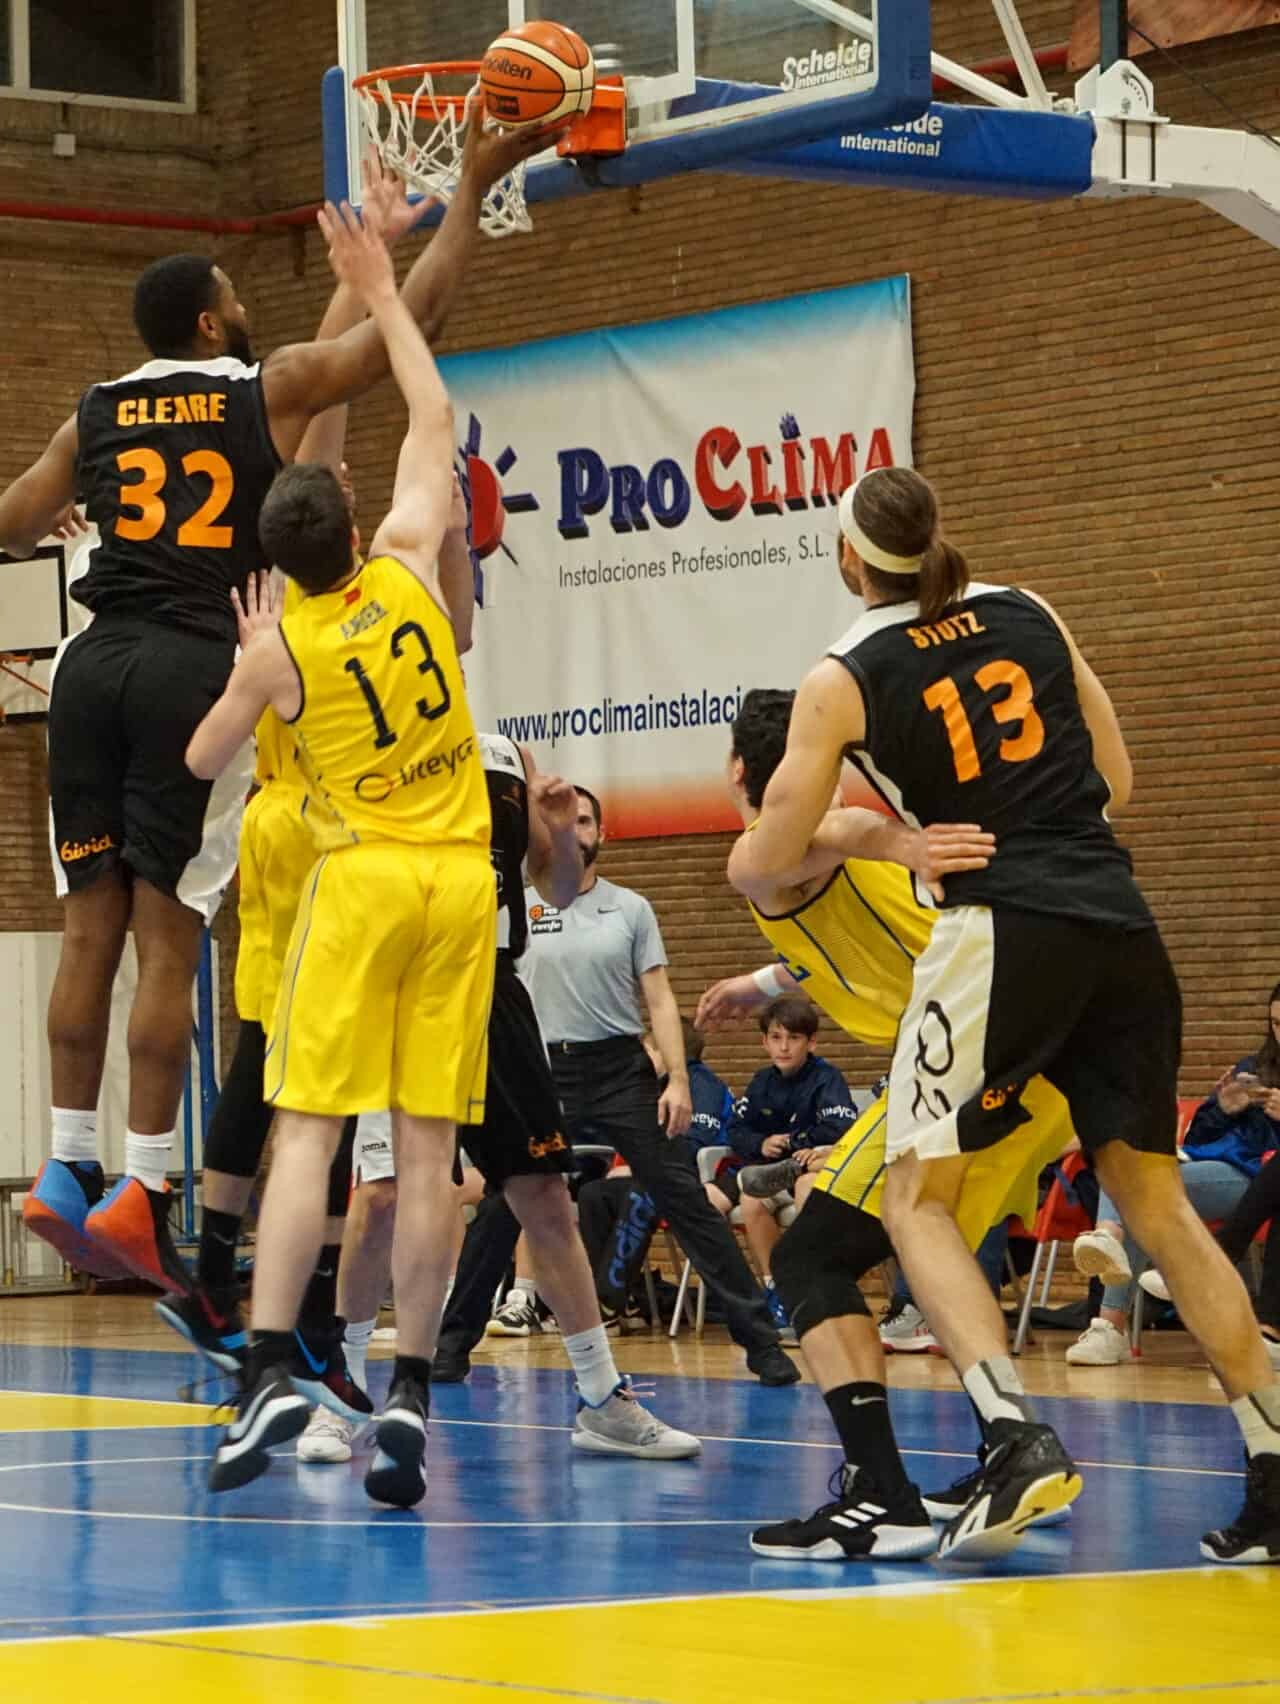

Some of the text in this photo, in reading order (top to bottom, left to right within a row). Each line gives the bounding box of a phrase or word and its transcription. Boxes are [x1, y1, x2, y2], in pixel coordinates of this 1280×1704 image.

[780, 39, 872, 91] Schelde
[117, 392, 227, 427] CLEARE
[113, 447, 235, 548] 32
[558, 534, 830, 589] Instalaciones Profesionales, S.L.
[905, 610, 987, 649] STUTZ
[344, 620, 451, 751] 13
[923, 659, 1046, 785] 13
